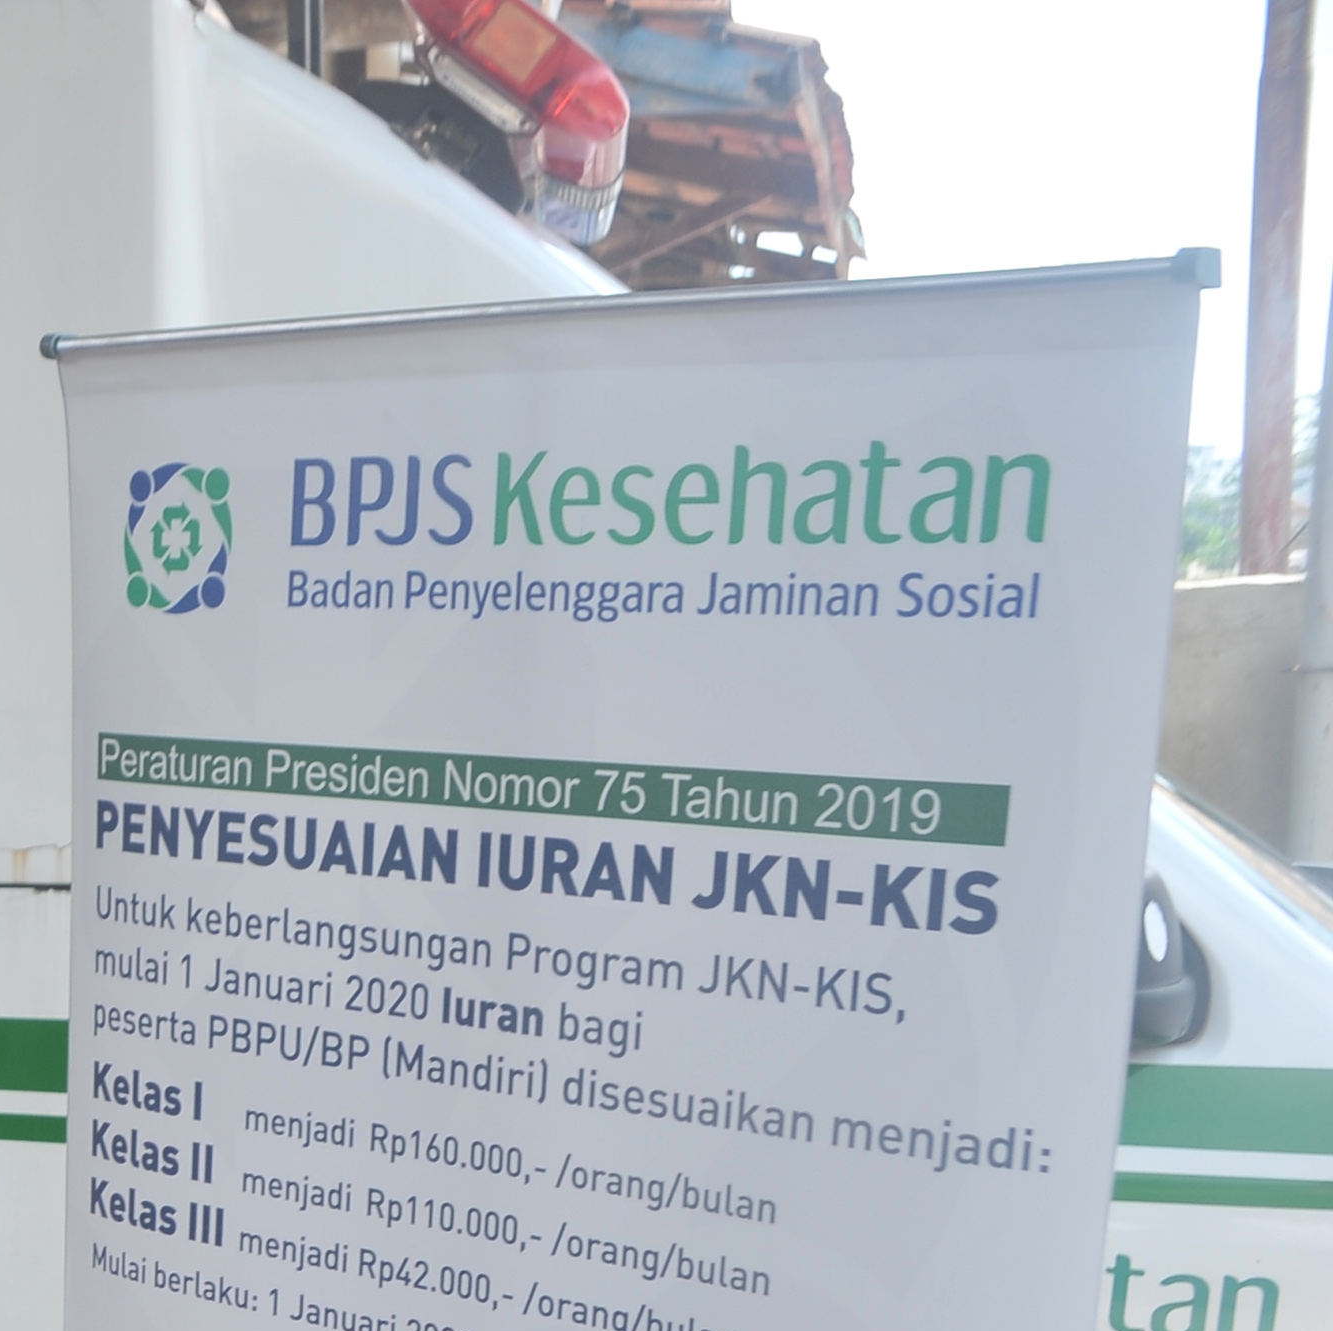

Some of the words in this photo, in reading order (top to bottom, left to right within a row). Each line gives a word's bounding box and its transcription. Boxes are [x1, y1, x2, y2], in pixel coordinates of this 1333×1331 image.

[290, 454, 473, 546] BPJS
[494, 440, 1051, 545] Kesehatan
[287, 570, 393, 609] Badan
[405, 571, 684, 622] Penyelenggara
[697, 572, 879, 616] Jaminan
[896, 572, 1040, 618] Sosial
[103, 740, 251, 785] Peraturan
[267, 750, 428, 797] Presiden
[445, 760, 580, 808] Nomor
[595, 770, 645, 813] 75
[662, 774, 798, 824] Tahun
[815, 784, 940, 834] 2019
[96, 800, 458, 884] PENYESUAIAN
[478, 832, 674, 905] IURAN
[691, 851, 1000, 935] JKN-KIS
[95, 947, 168, 985] mulai
[181, 954, 191, 989] 1
[204, 958, 332, 1008] Januari
[345, 975, 429, 1020] 2020
[442, 987, 543, 1037] Iuran
[559, 1002, 643, 1058] bagi
[96, 885, 175, 930] Untuk
[187, 897, 491, 971] keberlangsungan
[507, 932, 683, 990] Program
[697, 954, 905, 1025] JKN-KIS,
[93, 1061, 181, 1116] Kelas
[193, 1081, 203, 1121] I
[245, 1109, 355, 1148] menjadi
[370, 1123, 546, 1185] Rp160.000,-
[555, 1153, 776, 1224] /orang/bulan
[94, 1004, 196, 1046] peserta
[209, 1015, 370, 1070] PBPU/BP
[383, 1036, 548, 1104] (Mandiri)
[563, 1068, 814, 1142] disesuaikan
[831, 1117, 1051, 1173] menjadi:
[90, 1177, 176, 1235] Kelas
[189, 1202, 224, 1247] III
[239, 1232, 348, 1273] menjadi
[358, 1248, 514, 1311] Rp42.000,-
[92, 1119, 179, 1176] Kelas
[191, 1142, 213, 1184] II
[242, 1172, 351, 1212] menjadi
[367, 1188, 542, 1252] Rp110.000,-
[550, 1222, 770, 1296] /orang/bulan
[92, 1242, 146, 1284] Mulai
[154, 1261, 258, 1312] berlaku:
[269, 1288, 278, 1316] 1
